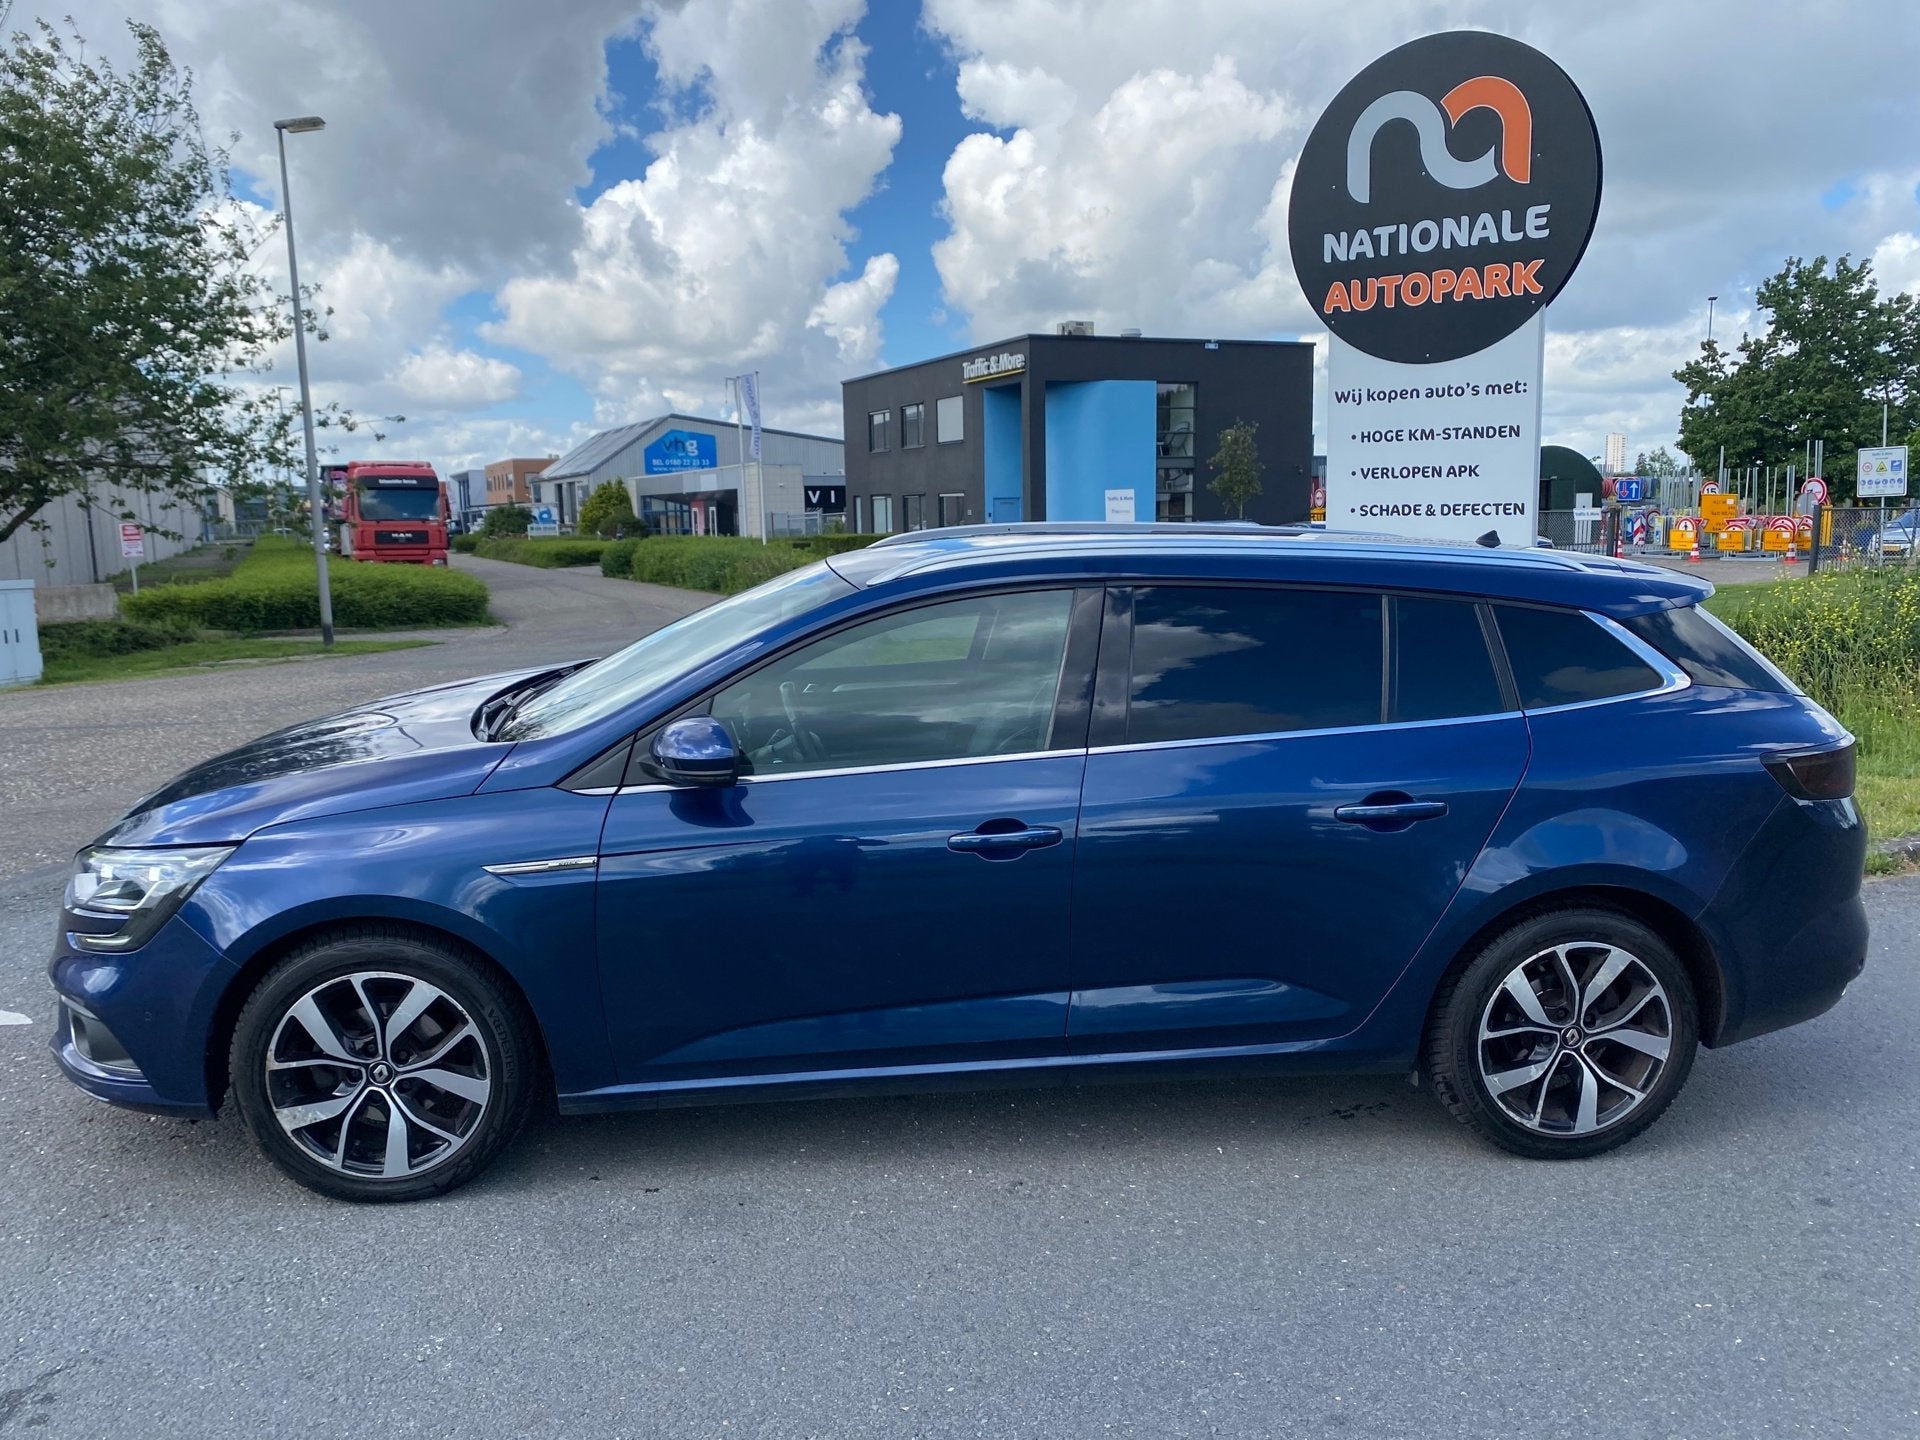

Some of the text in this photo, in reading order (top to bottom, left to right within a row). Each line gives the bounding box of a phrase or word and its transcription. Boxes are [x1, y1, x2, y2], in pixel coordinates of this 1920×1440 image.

[1323, 204, 1551, 263] NATIONALE
[1323, 259, 1545, 314] AUTOPARK
[962, 357, 990, 379] Traffic
[999, 352, 1026, 372] More
[1335, 380, 1528, 405] Wij kopen auto's met:
[663, 437, 698, 456] vhg
[1360, 425, 1521, 443] HOGE KM-STANDEN
[1360, 464, 1480, 479] VERLOPEN APK
[1359, 502, 1525, 517] SCHADE & DEFECTEN
[488, 1007, 514, 1080] VREDESTEIN
